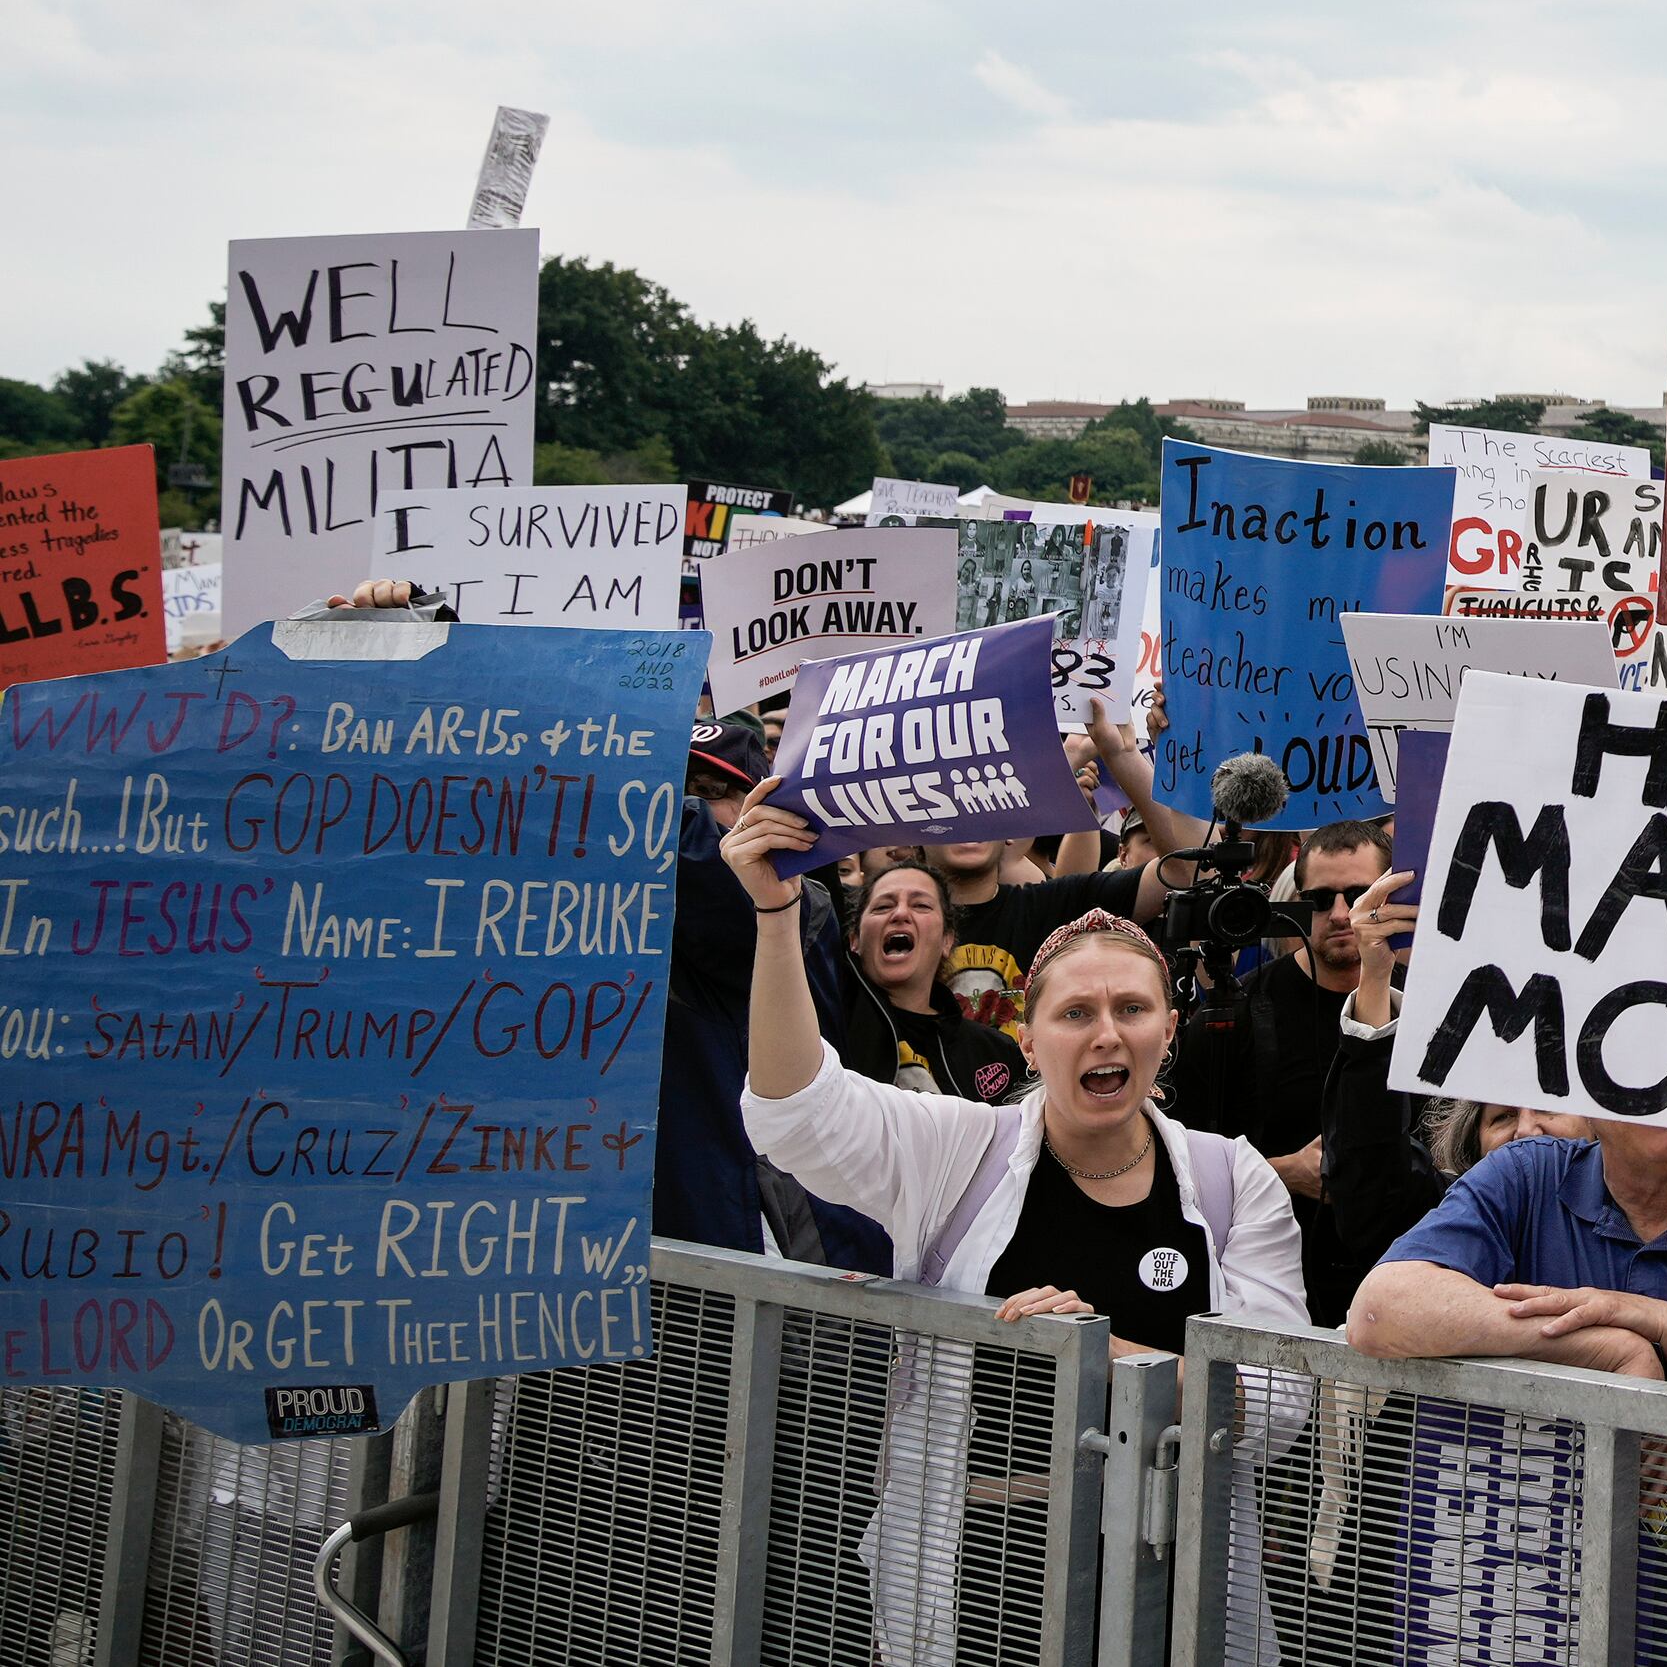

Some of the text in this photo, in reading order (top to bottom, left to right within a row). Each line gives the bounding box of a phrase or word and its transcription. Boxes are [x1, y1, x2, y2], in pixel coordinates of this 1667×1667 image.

[239, 250, 498, 353] WELL
[236, 343, 533, 431] REGULATED
[1445, 430, 1628, 473] The Scariest
[59, 500, 98, 523] the
[235, 435, 513, 540] MILITIA
[706, 484, 774, 510] PROTECT
[1175, 455, 1427, 550] Inaction
[41, 524, 120, 555] tragedies
[388, 506, 434, 553] I
[470, 501, 679, 549] SURVIVED
[691, 540, 721, 559] NOT
[499, 574, 538, 614] I
[562, 575, 642, 616] AM
[773, 557, 877, 601] DON'T
[1166, 560, 1267, 617] makes
[625, 638, 687, 659] 2018
[732, 601, 923, 660] LOOK AWAY.
[634, 660, 675, 677] AND
[818, 637, 983, 717] MARCH
[1164, 619, 1293, 697] teacher
[617, 675, 675, 692] 2022
[801, 696, 1011, 779] FOR OUR
[1164, 730, 1207, 791] get
[223, 771, 354, 857] GOP
[363, 764, 598, 859] DOESN'T!
[608, 779, 677, 875] SO,
[802, 771, 960, 828] LIVES
[414, 877, 465, 958] I
[474, 882, 668, 957] REBUKE
[375, 1195, 587, 1279] RIGHT
[1152, 1251, 1179, 1262] VOTE
[1152, 1278, 1174, 1287] NRA
[1154, 1260, 1176, 1269] OUT
[1154, 1269, 1174, 1278] THE
[40, 1286, 645, 1376] LORD OR GET THEE HENCE!
[277, 1387, 365, 1418] PROUD
[283, 1414, 366, 1433] DEMOCRAT
